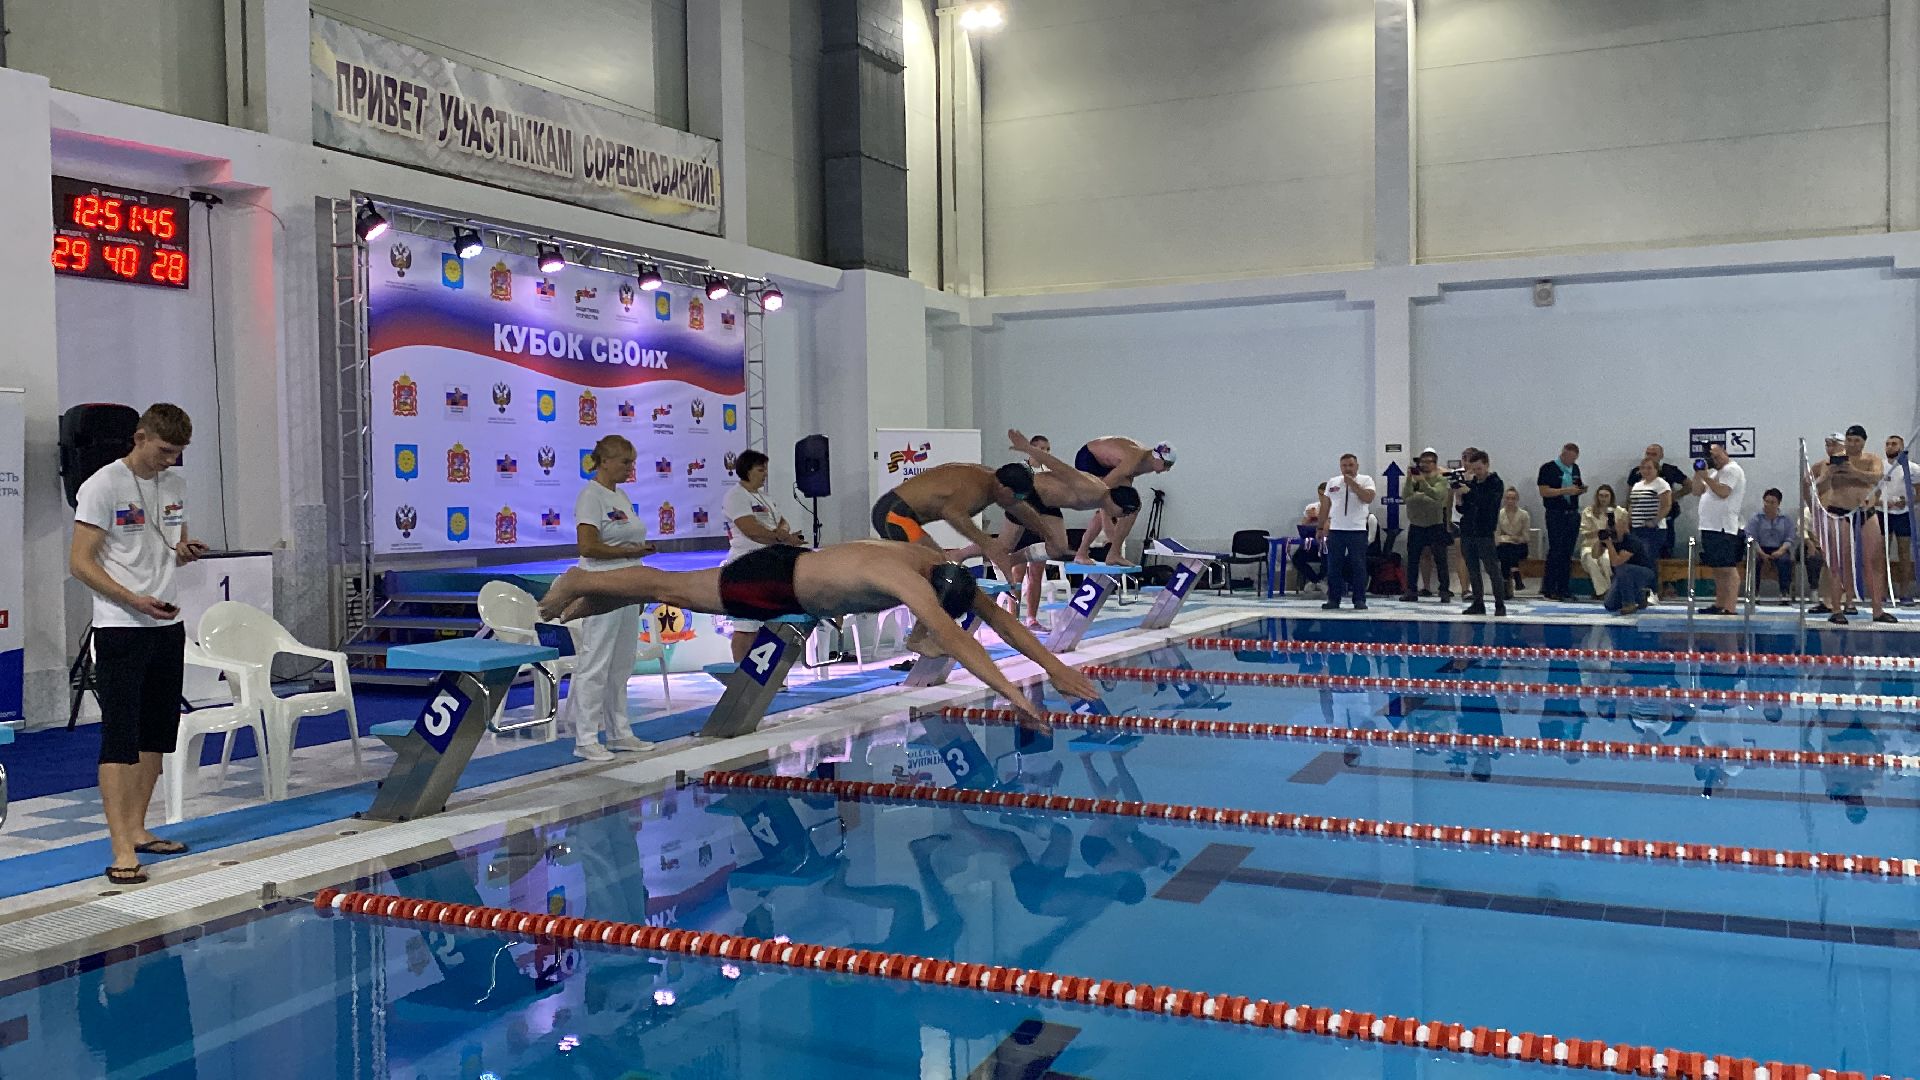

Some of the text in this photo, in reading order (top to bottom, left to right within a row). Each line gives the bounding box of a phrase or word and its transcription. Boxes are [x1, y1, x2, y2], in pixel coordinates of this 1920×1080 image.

[335, 60, 715, 205] ПРИВЕТ УЧАСТНИКАМ СОРЕВНОВАНИЙ!
[53, 236, 184, 282] 29 40 28
[494, 322, 669, 370] КУБОК СВОих
[219, 576, 230, 601] 1
[1073, 584, 1097, 611] 2
[1174, 572, 1190, 592] 1
[748, 641, 778, 675] 4
[424, 695, 460, 737] 5
